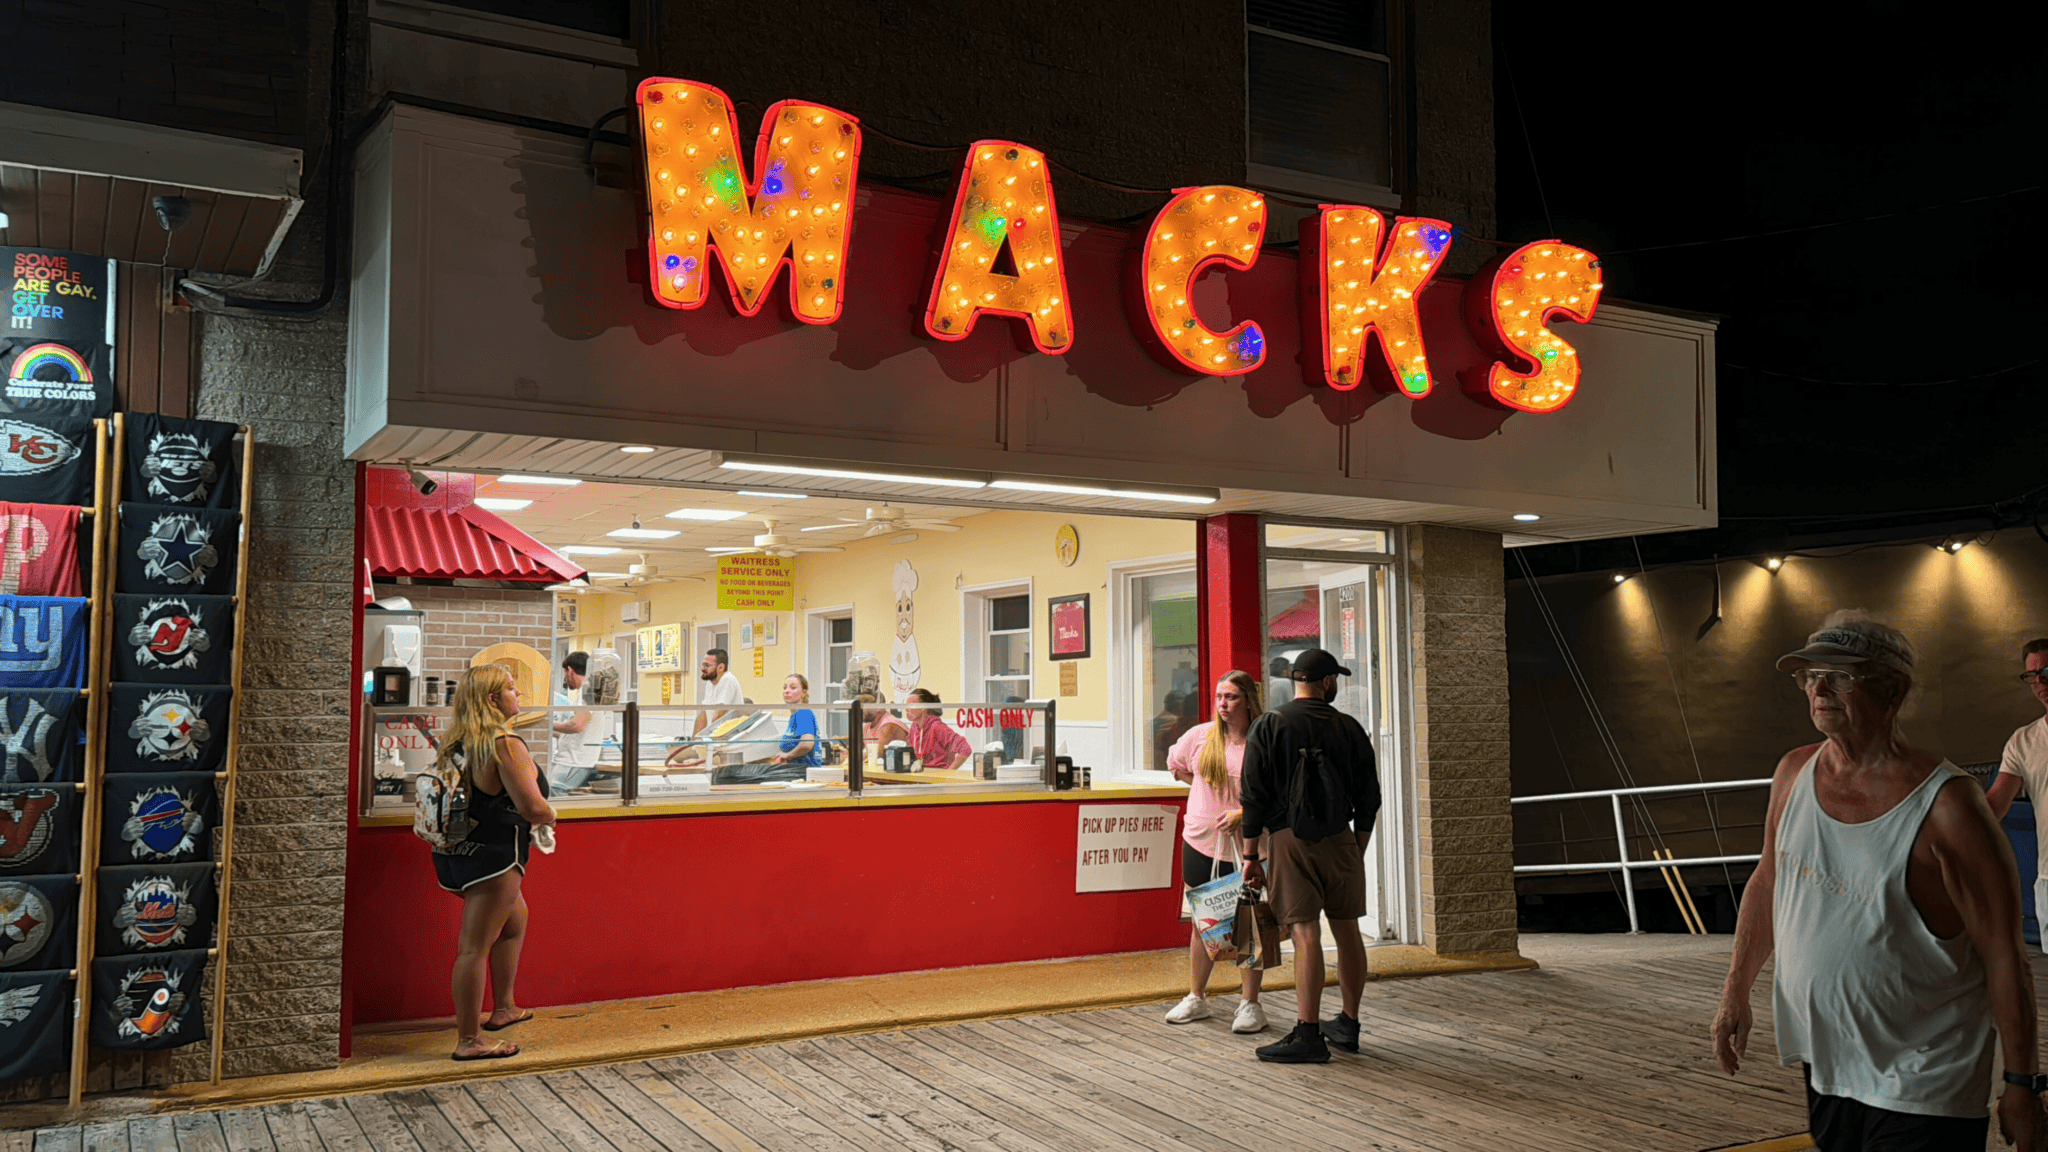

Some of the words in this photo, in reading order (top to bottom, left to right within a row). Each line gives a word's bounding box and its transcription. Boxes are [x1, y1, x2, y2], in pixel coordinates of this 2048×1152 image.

[636, 76, 1602, 413] MACKS
[14, 252, 68, 270] SOME
[13, 265, 82, 285] PEOPLE
[13, 278, 50, 293] ARE
[55, 281, 97, 300] GAY.
[12, 290, 48, 305] GET
[12, 303, 64, 320] OVER
[11, 315, 33, 330] IT!
[5, 386, 43, 399] TRUE
[43, 388, 97, 401] COLORS
[66, 382, 94, 391] your
[731, 557, 780, 566] WAITRESS
[721, 567, 762, 575] SERVICE
[765, 568, 790, 577] ONLY
[385, 715, 437, 730] CASH
[956, 707, 994, 729] CASH
[999, 707, 1034, 730] ONLY
[380, 735, 442, 750] ONLY
[1082, 817, 1102, 834] PICK
[1104, 817, 1117, 833] UP
[1119, 816, 1139, 833] PIES
[1141, 816, 1165, 832] HERE
[1082, 848, 1109, 866] AFTER
[1112, 847, 1129, 863] YOU
[1132, 846, 1149, 863] PAY
